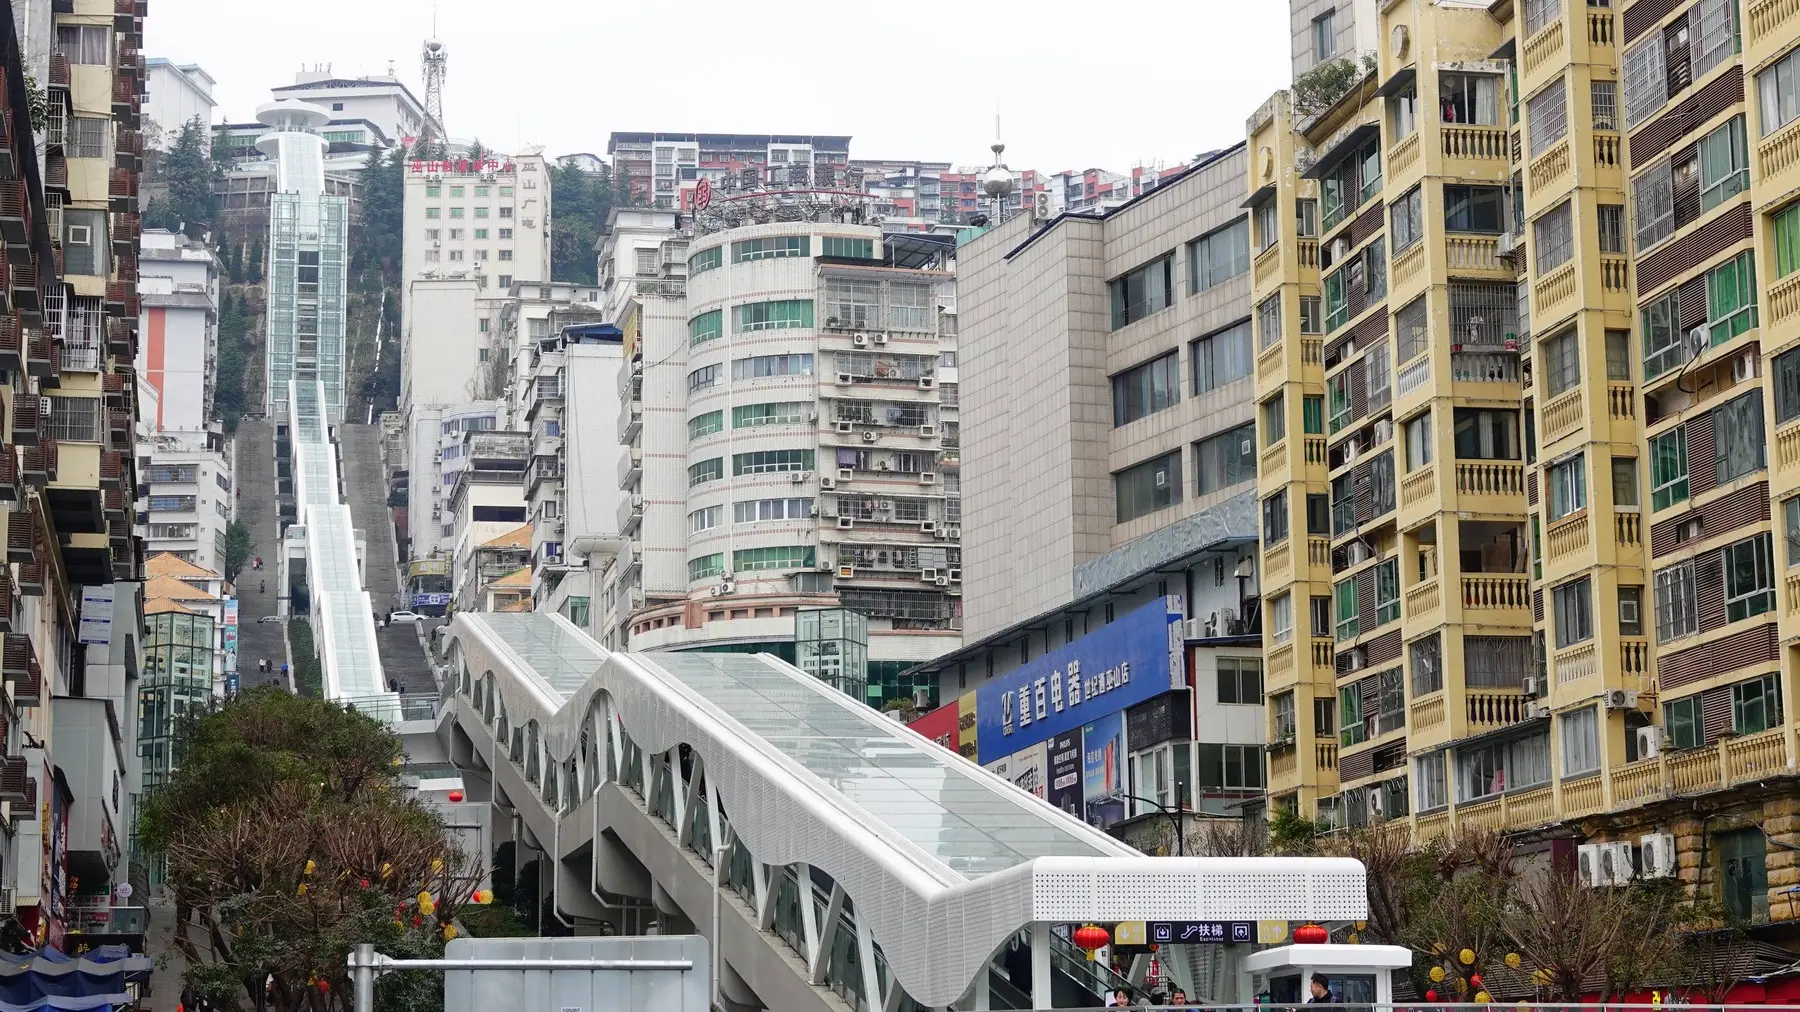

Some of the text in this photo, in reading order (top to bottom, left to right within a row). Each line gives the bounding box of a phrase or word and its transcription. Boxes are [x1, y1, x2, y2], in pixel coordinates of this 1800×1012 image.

[720, 164, 864, 194] 中国工商银行
[1019, 660, 1082, 727] 重百电器
[1199, 923, 1223, 937] 扶梯
